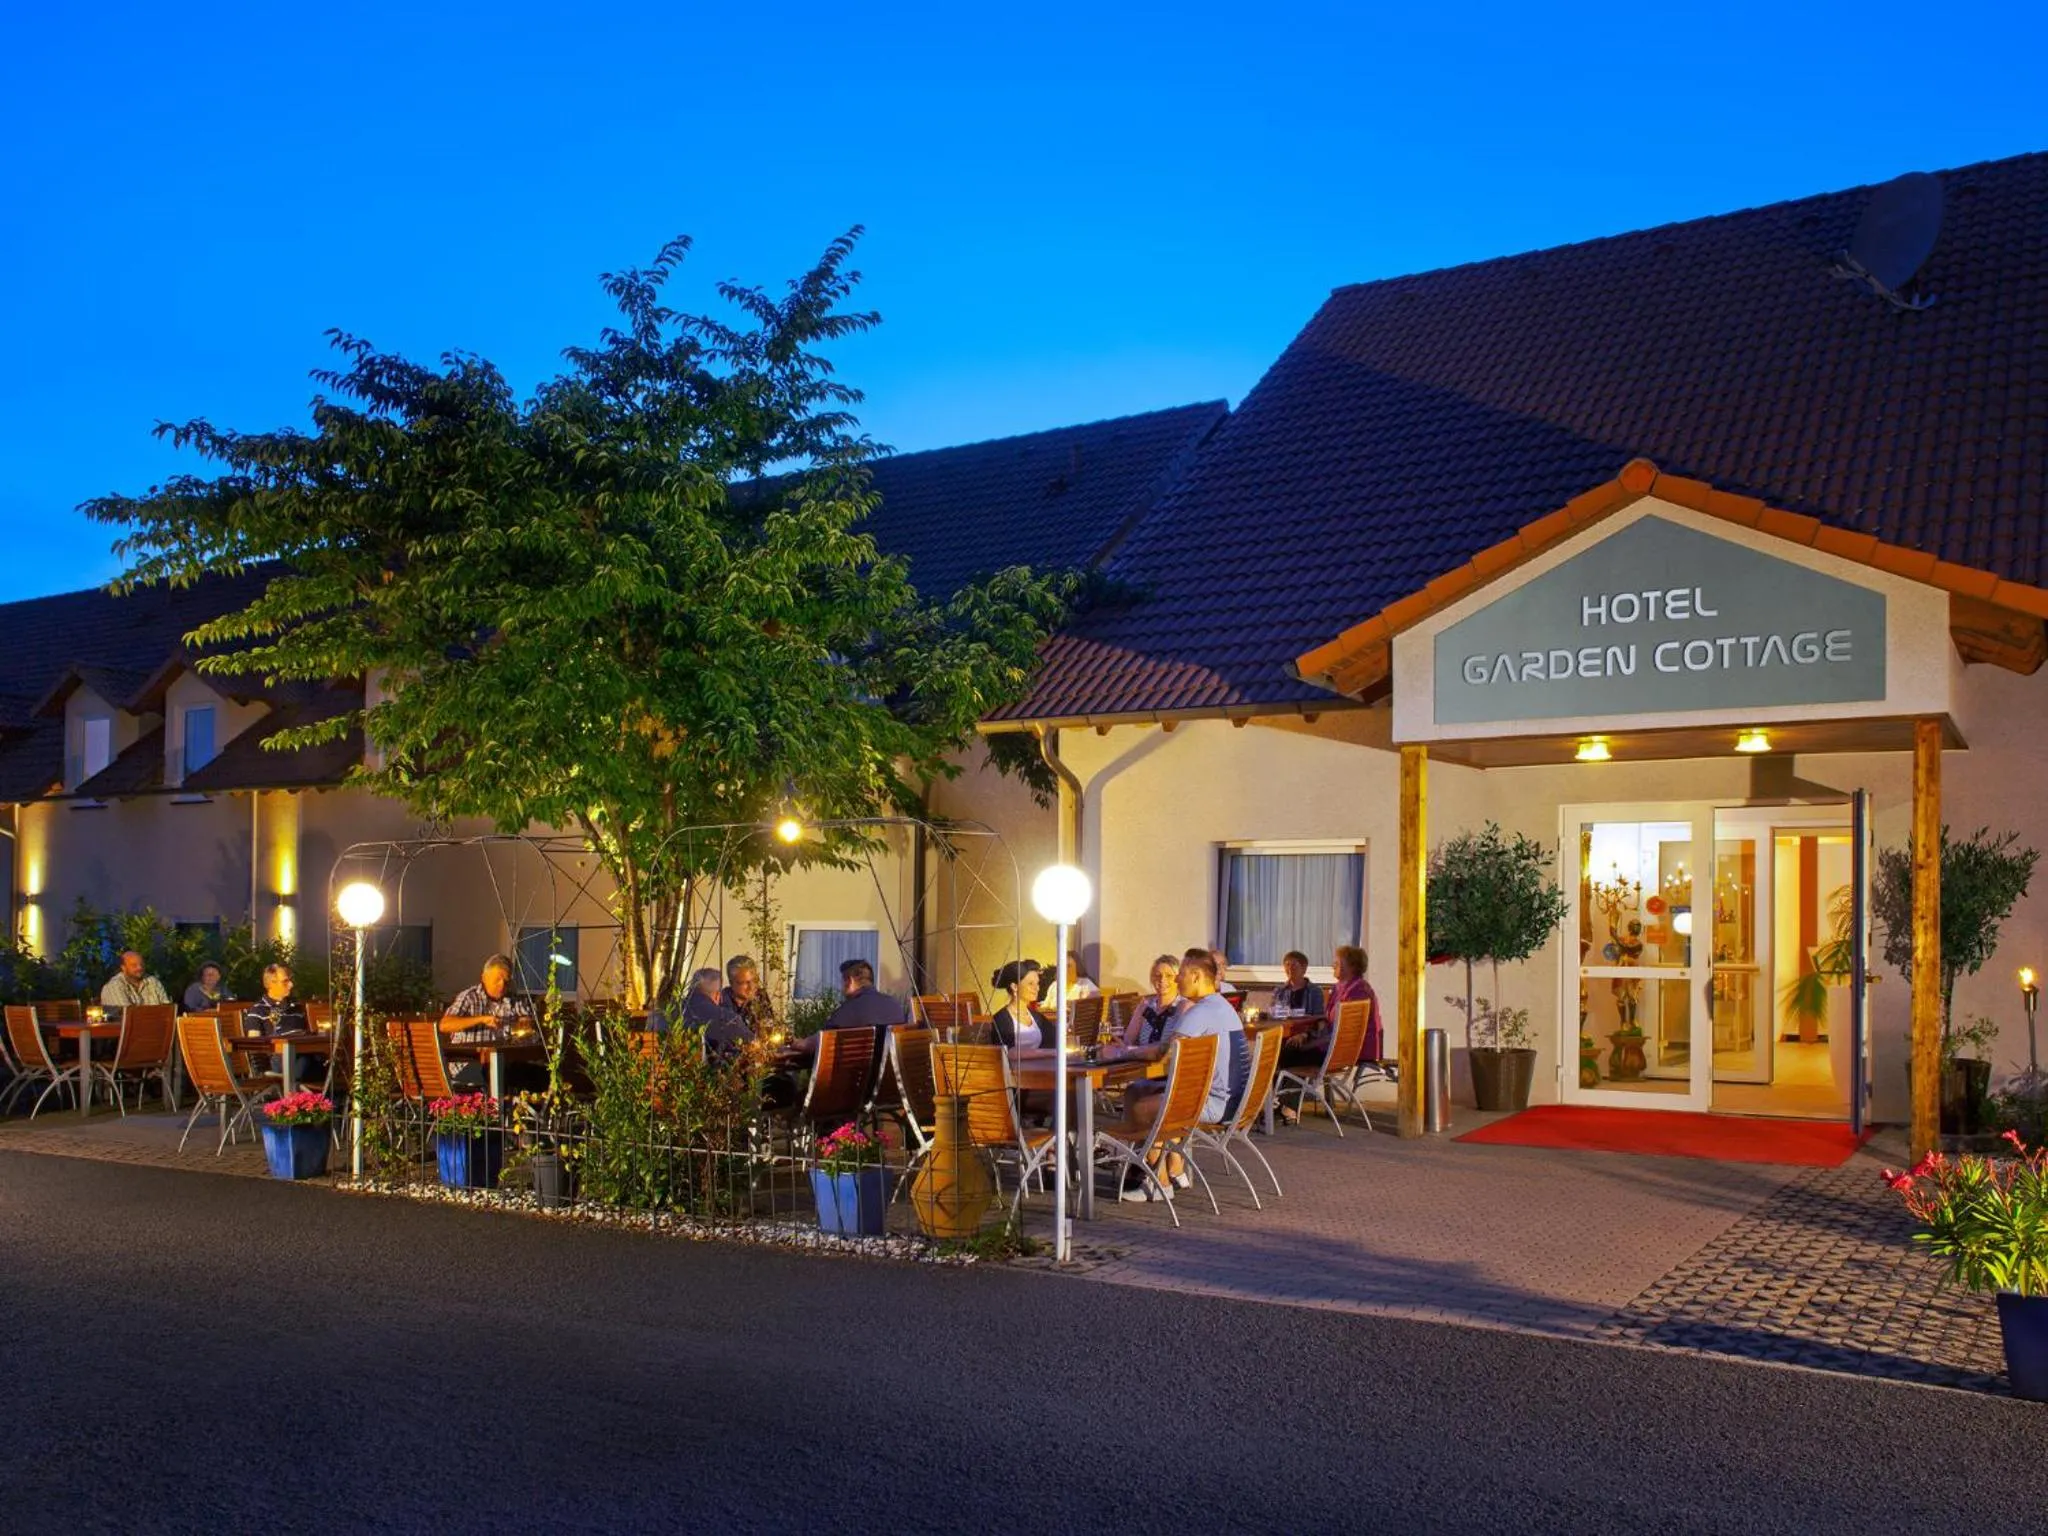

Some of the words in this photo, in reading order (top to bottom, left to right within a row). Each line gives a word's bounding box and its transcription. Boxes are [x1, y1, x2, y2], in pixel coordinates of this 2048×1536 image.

[1581, 588, 1718, 626] HOTEL
[1463, 643, 1637, 685] GARDEN
[1653, 630, 1853, 673] COTTAGE
